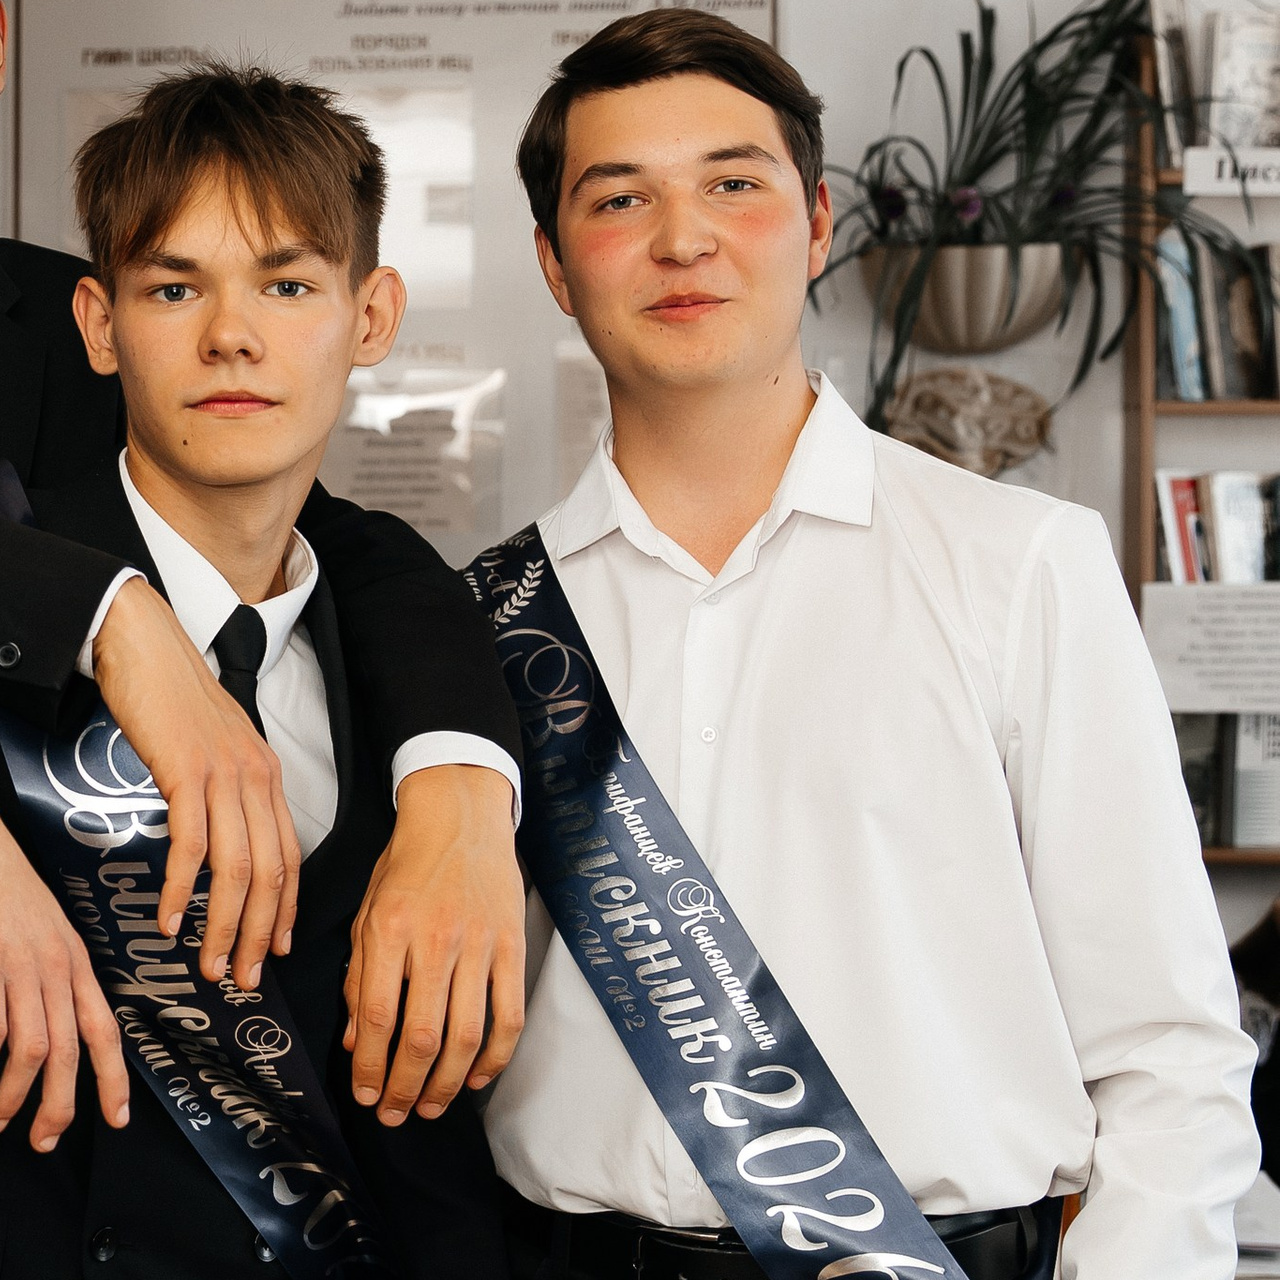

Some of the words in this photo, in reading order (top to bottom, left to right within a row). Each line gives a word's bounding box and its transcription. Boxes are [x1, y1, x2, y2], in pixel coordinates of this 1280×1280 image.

[42, 720, 277, 1152] Выпускник
[495, 627, 733, 1066] Выпускник
[665, 875, 780, 1054] Константин
[167, 1076, 212, 1132] №2
